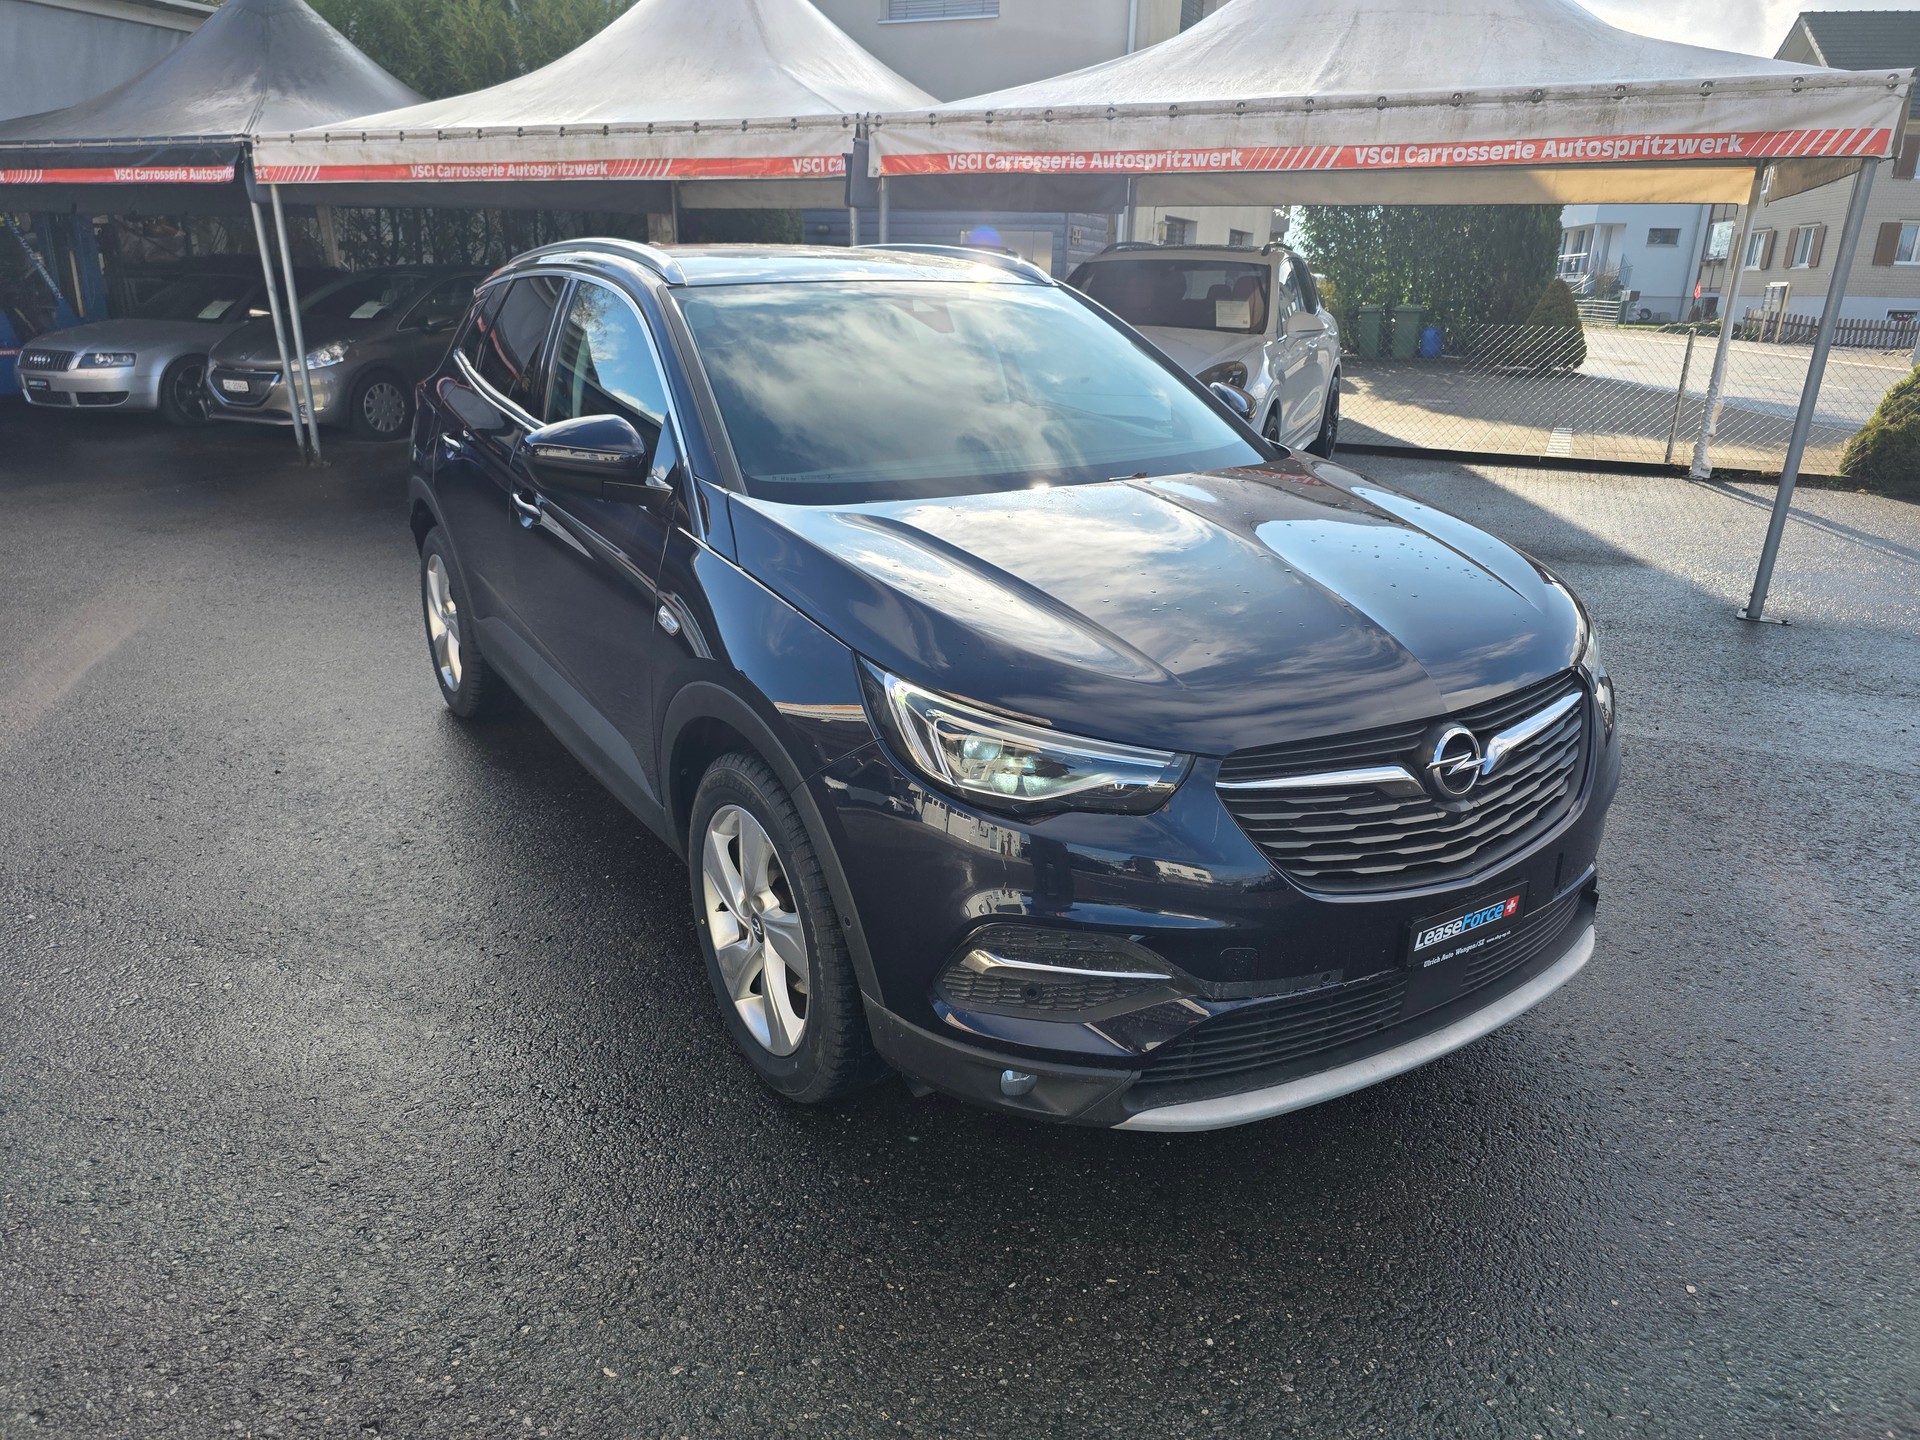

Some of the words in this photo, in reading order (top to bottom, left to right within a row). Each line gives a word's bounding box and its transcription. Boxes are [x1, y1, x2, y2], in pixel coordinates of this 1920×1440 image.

[1354, 147, 1400, 165] VSCI
[1404, 140, 1535, 164] Carrosserie
[1541, 134, 1743, 159] Autospritzwerk
[437, 163, 504, 177] Carrosserie
[507, 160, 608, 178] Autospritzwerk
[792, 157, 825, 173] VSCI
[947, 154, 982, 170] VSCI
[985, 152, 1086, 170] Carrosserie
[1090, 149, 1243, 171] Autospritzwerk
[134, 168, 188, 180] Carrosserie
[1414, 902, 1506, 950] LeaseForce
